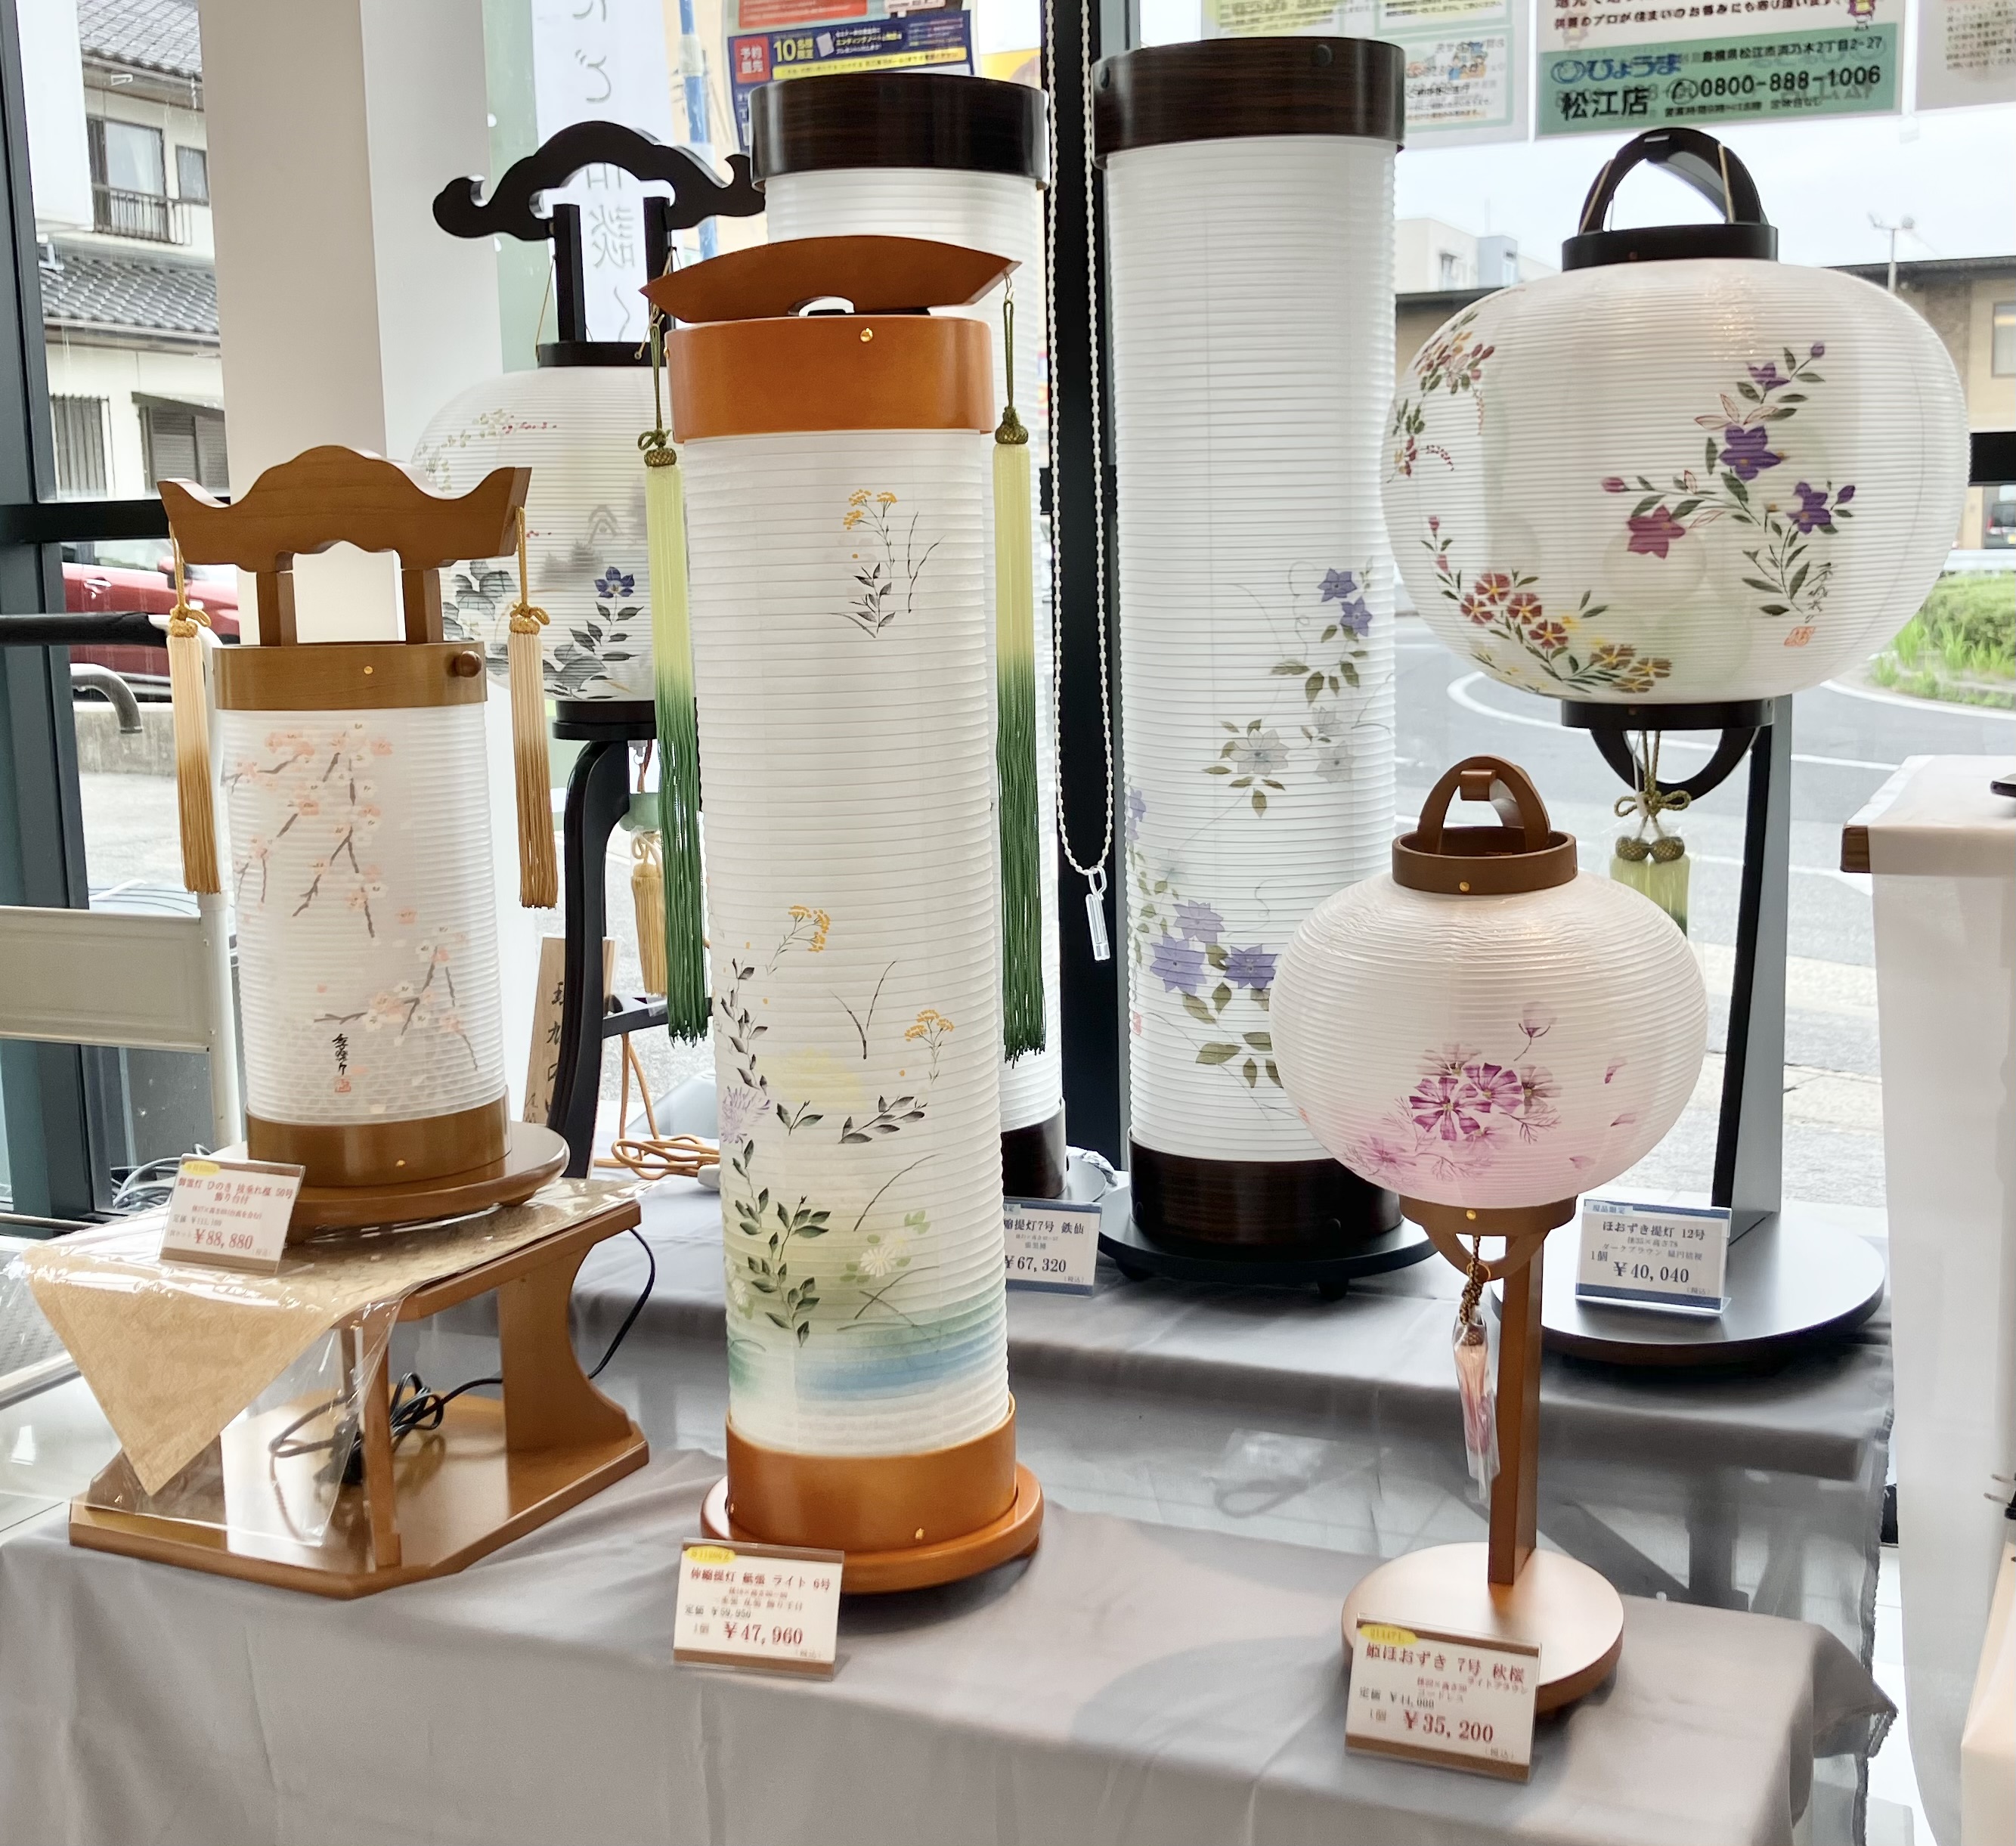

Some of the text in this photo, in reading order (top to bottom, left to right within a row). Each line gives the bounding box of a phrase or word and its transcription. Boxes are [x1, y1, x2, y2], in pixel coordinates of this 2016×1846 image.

[773, 39, 797, 62] 10
[1700, 66, 1881, 98] 0800-888-1006
[1559, 87, 1650, 121] 松江店
[207, 1181, 231, 1192] ひのき
[195, 1228, 254, 1250] ¥88,880
[1061, 1222, 1084, 1234] 鉄仙
[1603, 1222, 1705, 1240] ほおずき提灯 12号
[1602, 1243, 1663, 1256] ダークブラウン
[1005, 1255, 1067, 1272] ¥67,320
[1591, 1250, 1689, 1283] 1個 ¥40,040
[773, 1575, 806, 1587] ライト
[813, 1578, 831, 1591] 6号
[685, 1605, 704, 1615] 定価
[724, 1621, 804, 1645] ¥47,960
[1366, 1642, 1525, 1683] 姫ほおずき 7号 秋桜
[1404, 1709, 1494, 1743] ¥35,200
